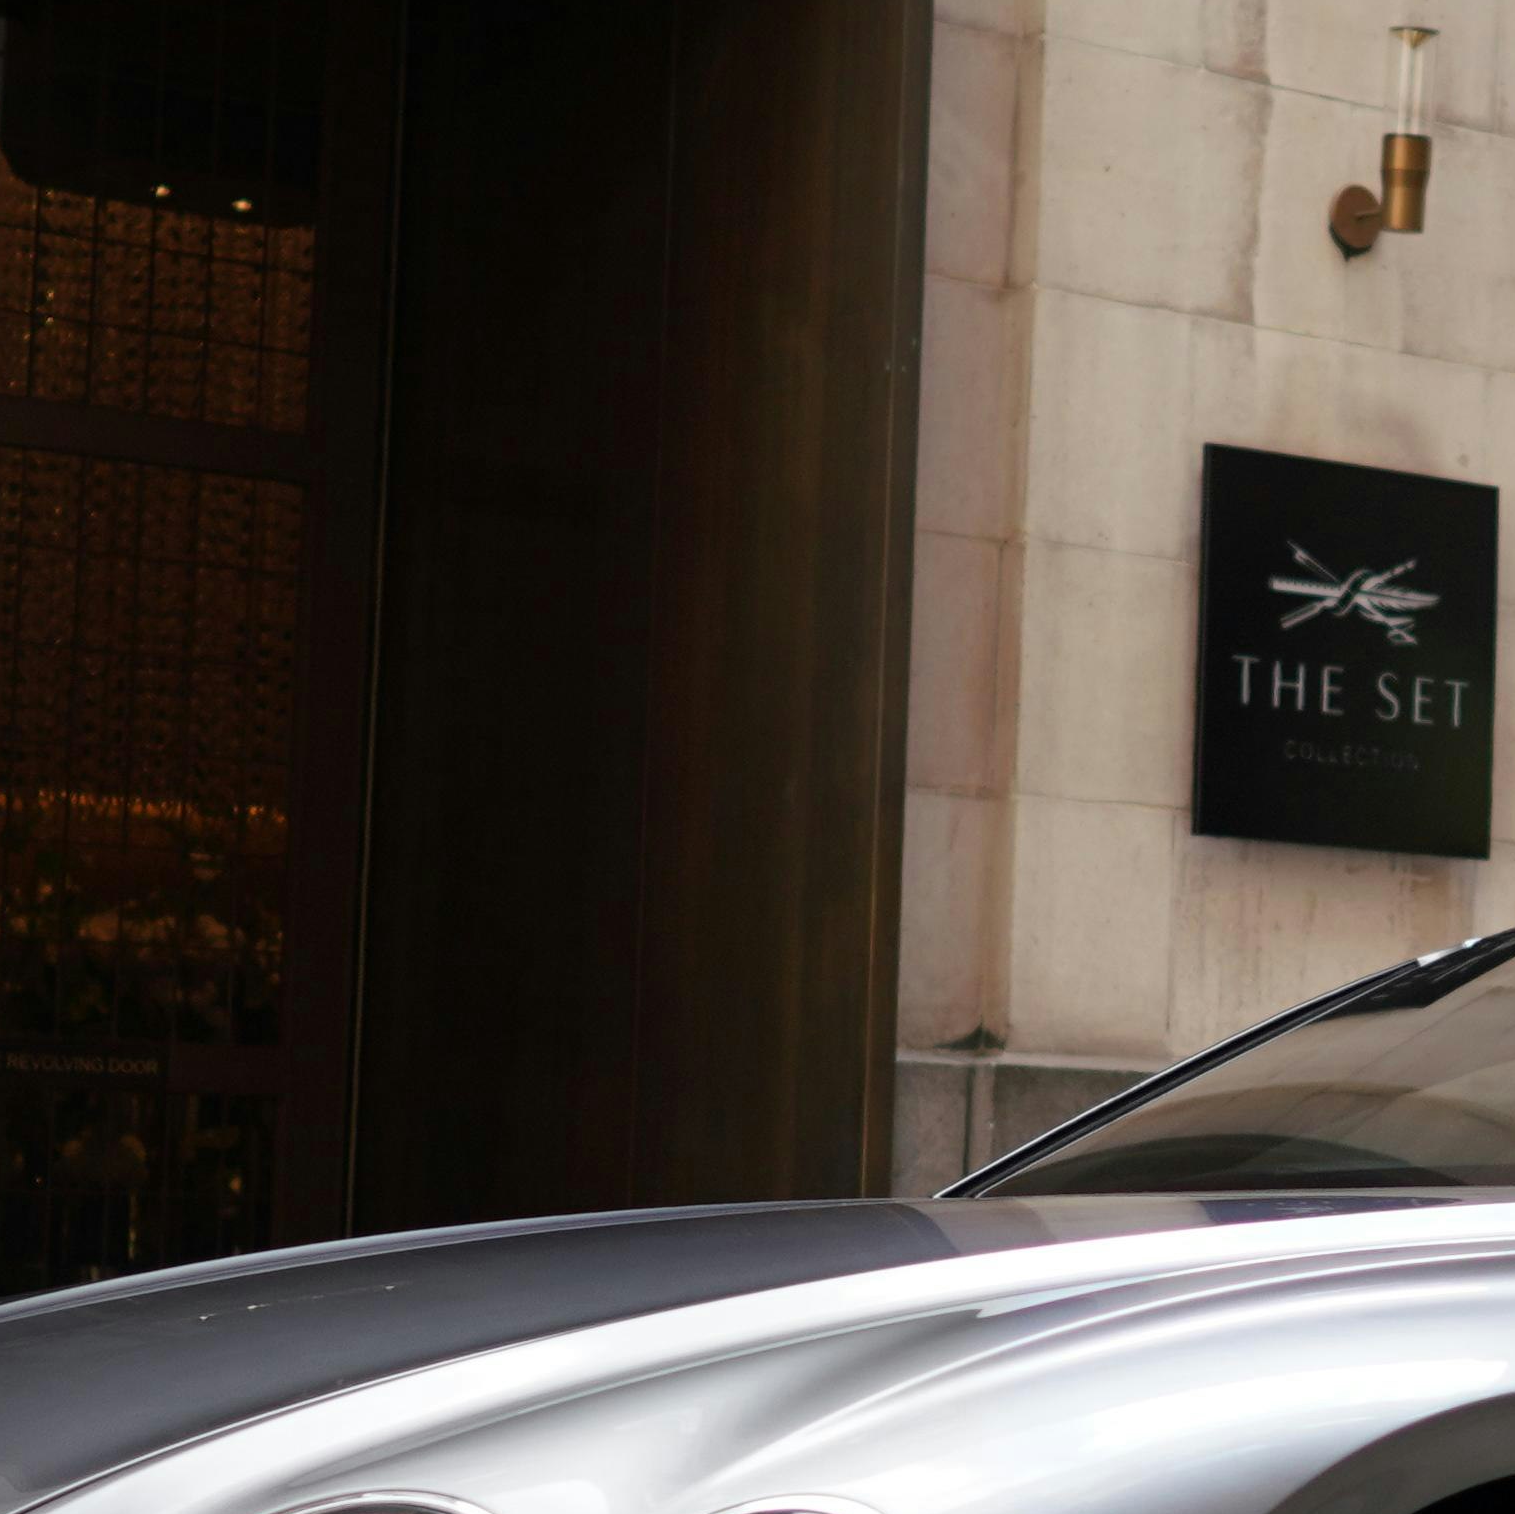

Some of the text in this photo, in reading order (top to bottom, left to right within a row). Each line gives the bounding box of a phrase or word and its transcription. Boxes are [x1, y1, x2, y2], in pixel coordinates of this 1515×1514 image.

[1232, 654, 1469, 728] THE SET
[5, 1053, 103, 1074] REVOLVING
[106, 1057, 159, 1077] DOOR
